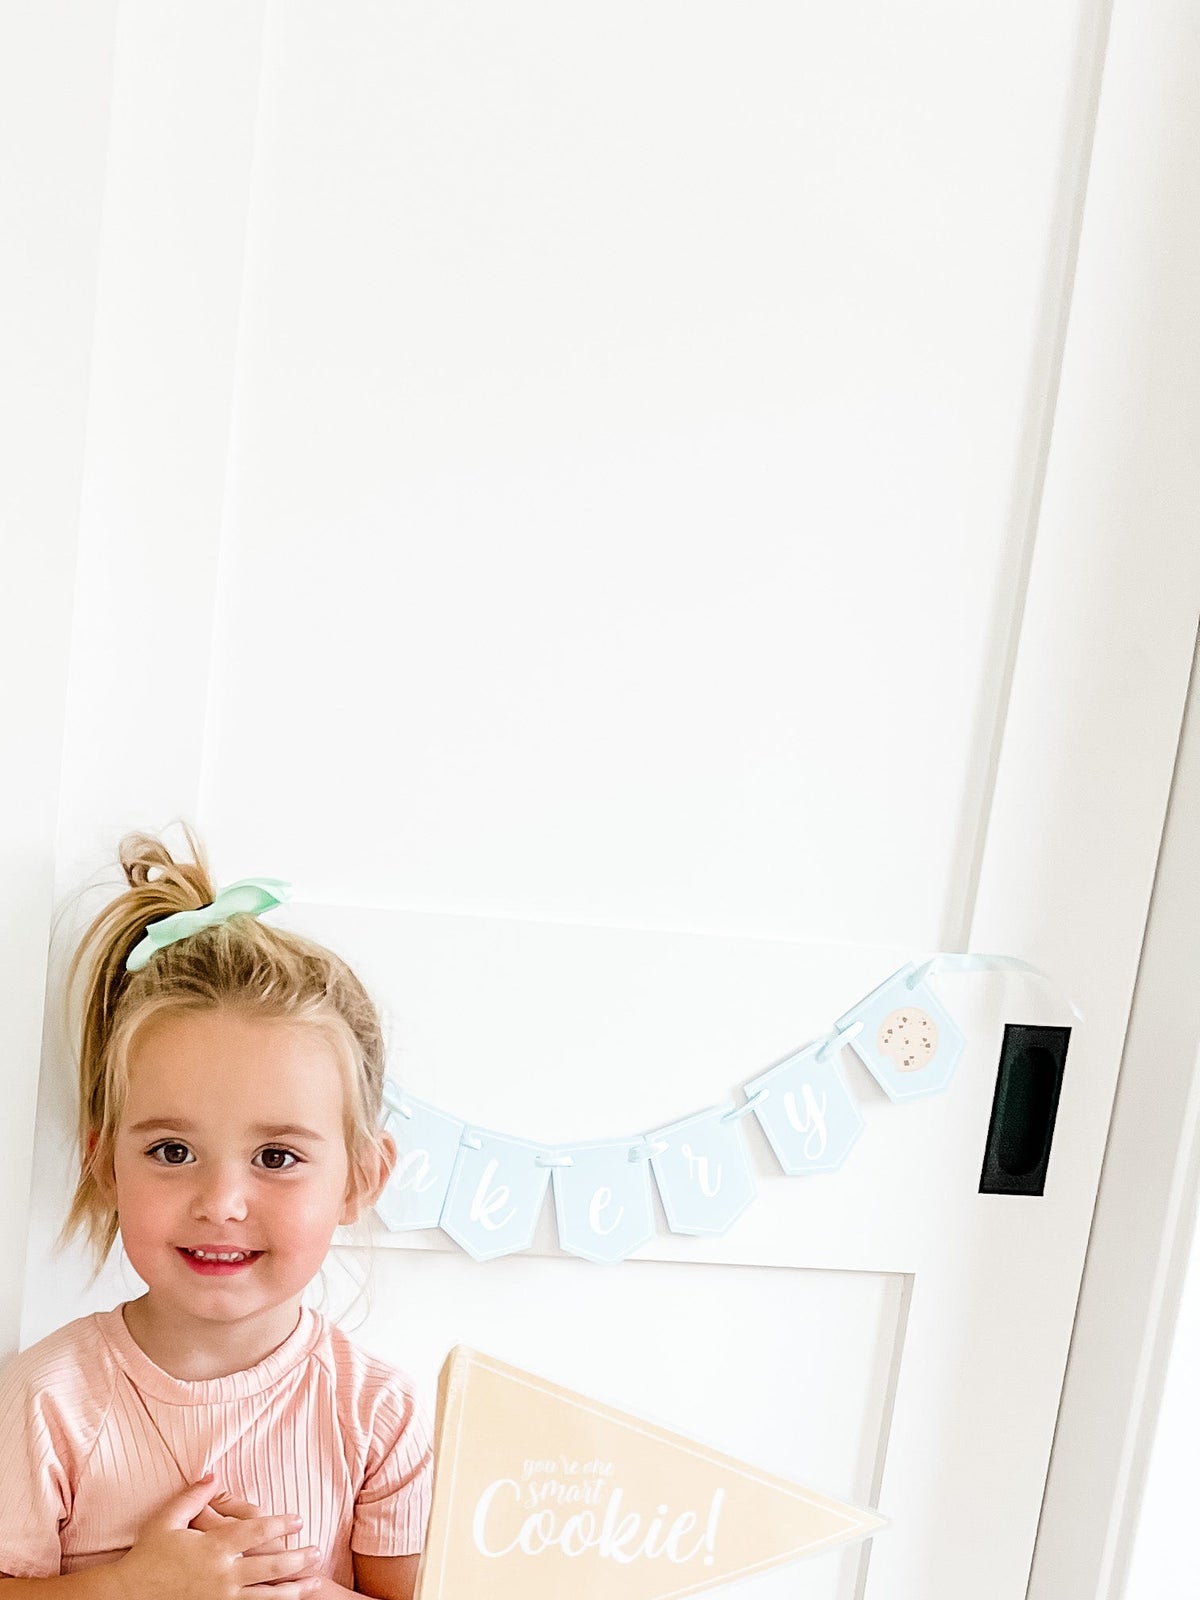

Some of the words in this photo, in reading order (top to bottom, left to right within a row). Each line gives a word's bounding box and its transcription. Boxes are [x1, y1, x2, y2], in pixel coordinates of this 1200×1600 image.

[392, 1081, 828, 1236] akery
[473, 1479, 725, 1567] Cookie!
[524, 1478, 607, 1509] smart
